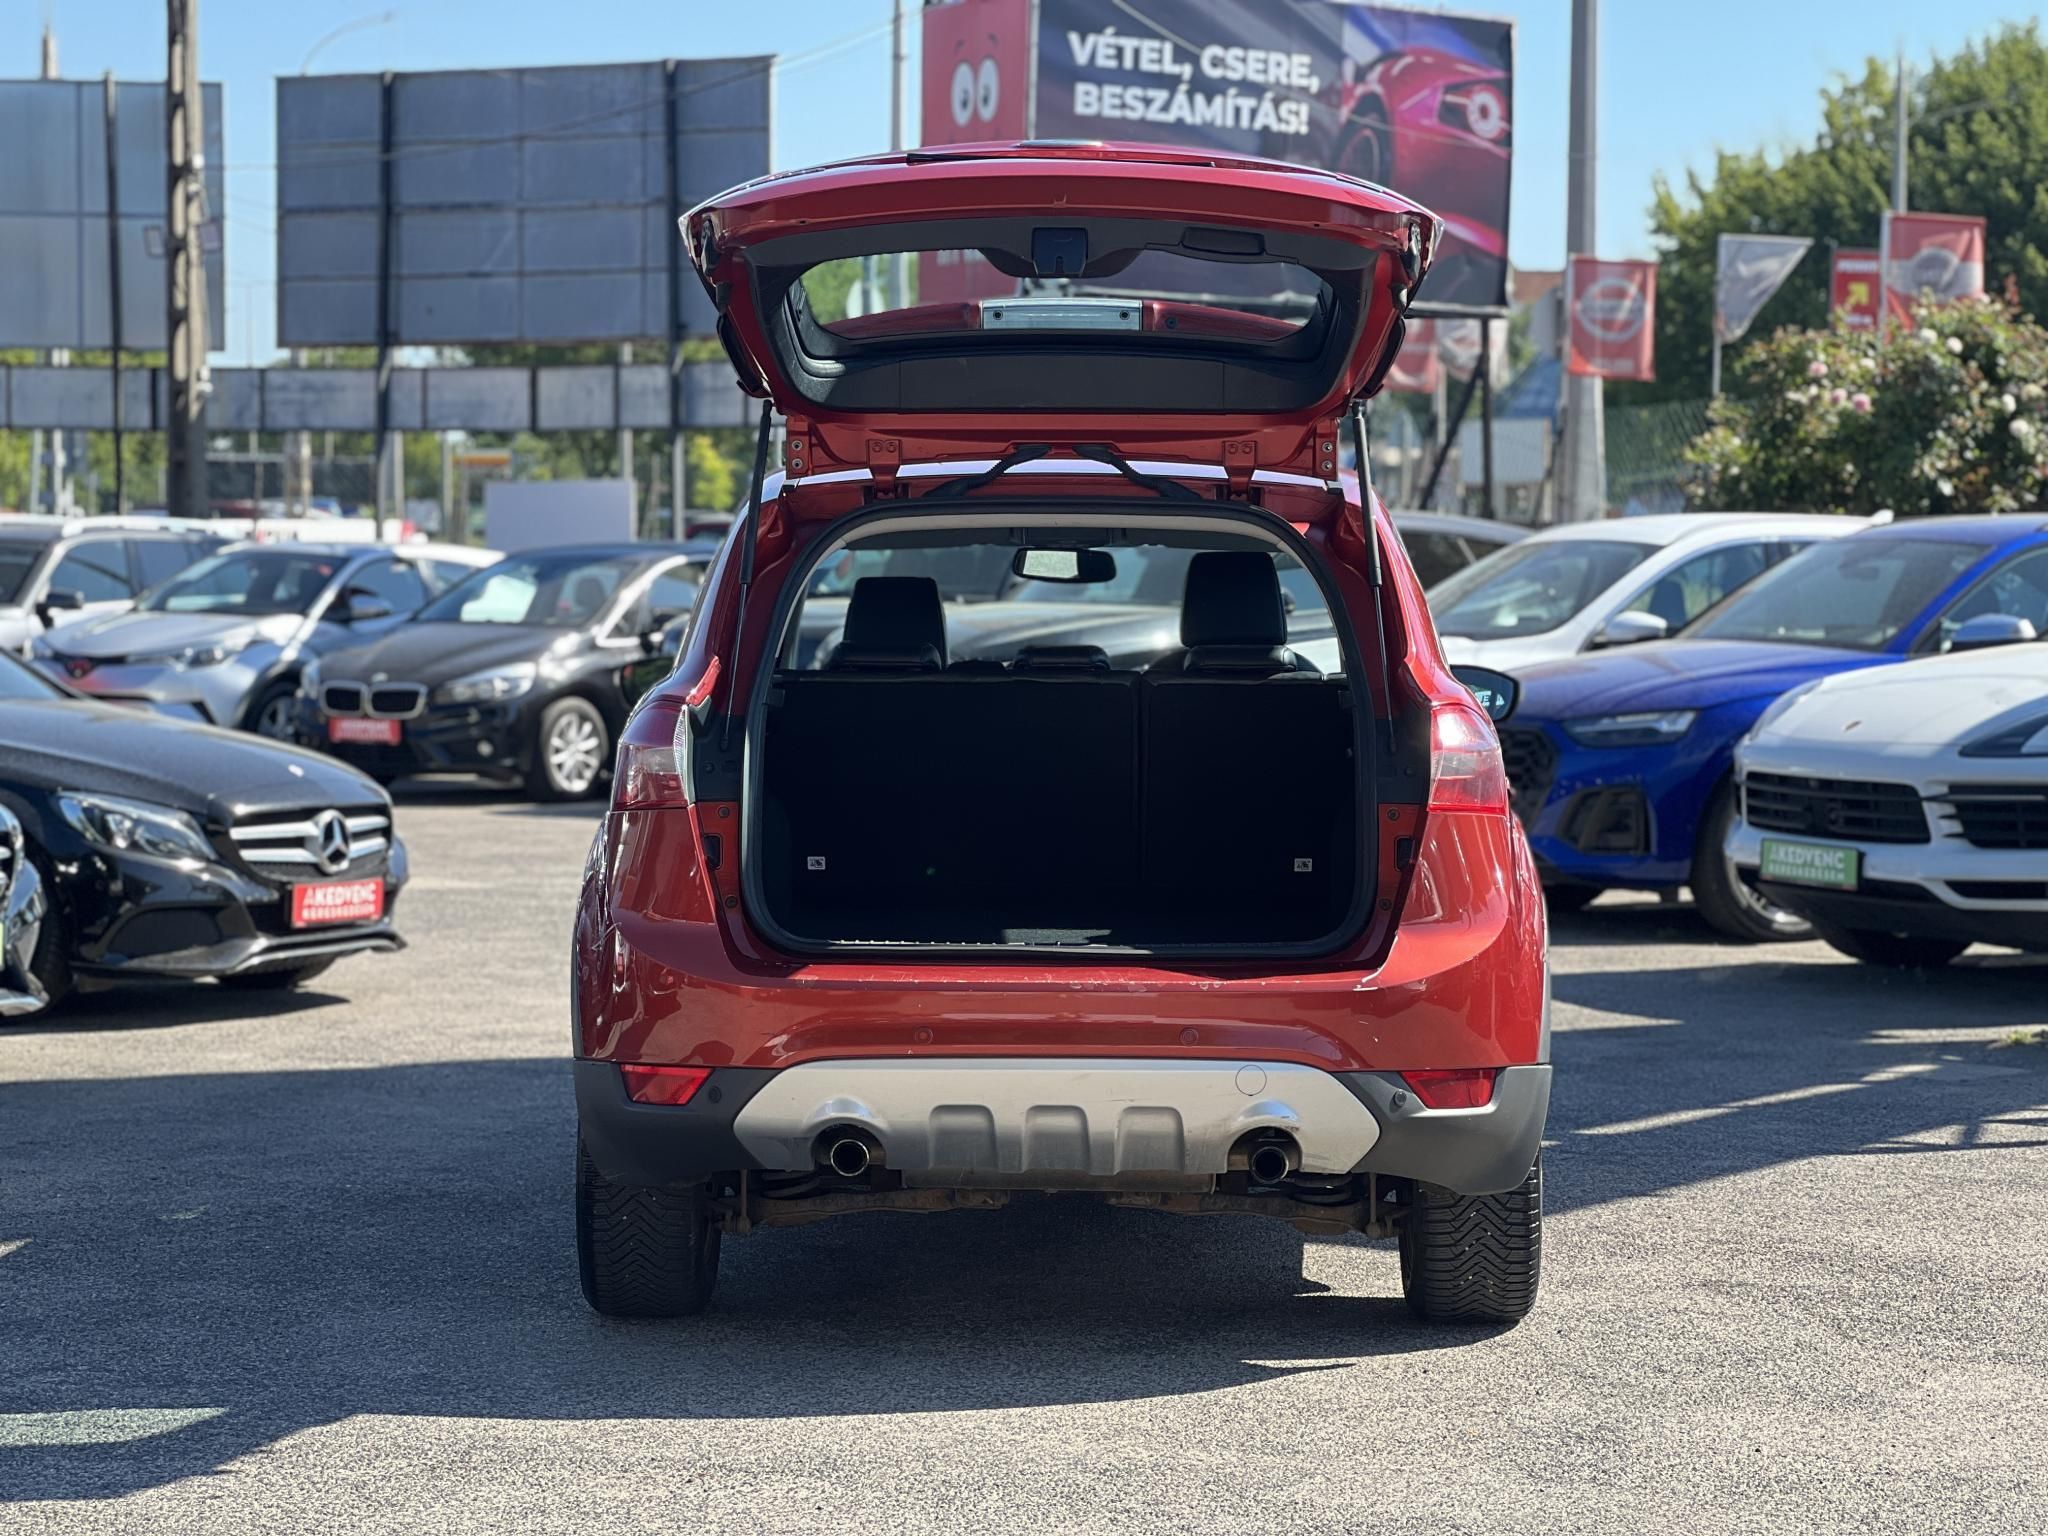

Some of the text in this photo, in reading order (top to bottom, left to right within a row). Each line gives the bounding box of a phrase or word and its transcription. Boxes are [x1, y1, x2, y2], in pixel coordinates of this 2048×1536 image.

[1067, 26, 1321, 94] VÉTEL, CSERE,
[1073, 82, 1310, 135] BESZÁMÍTÁS!
